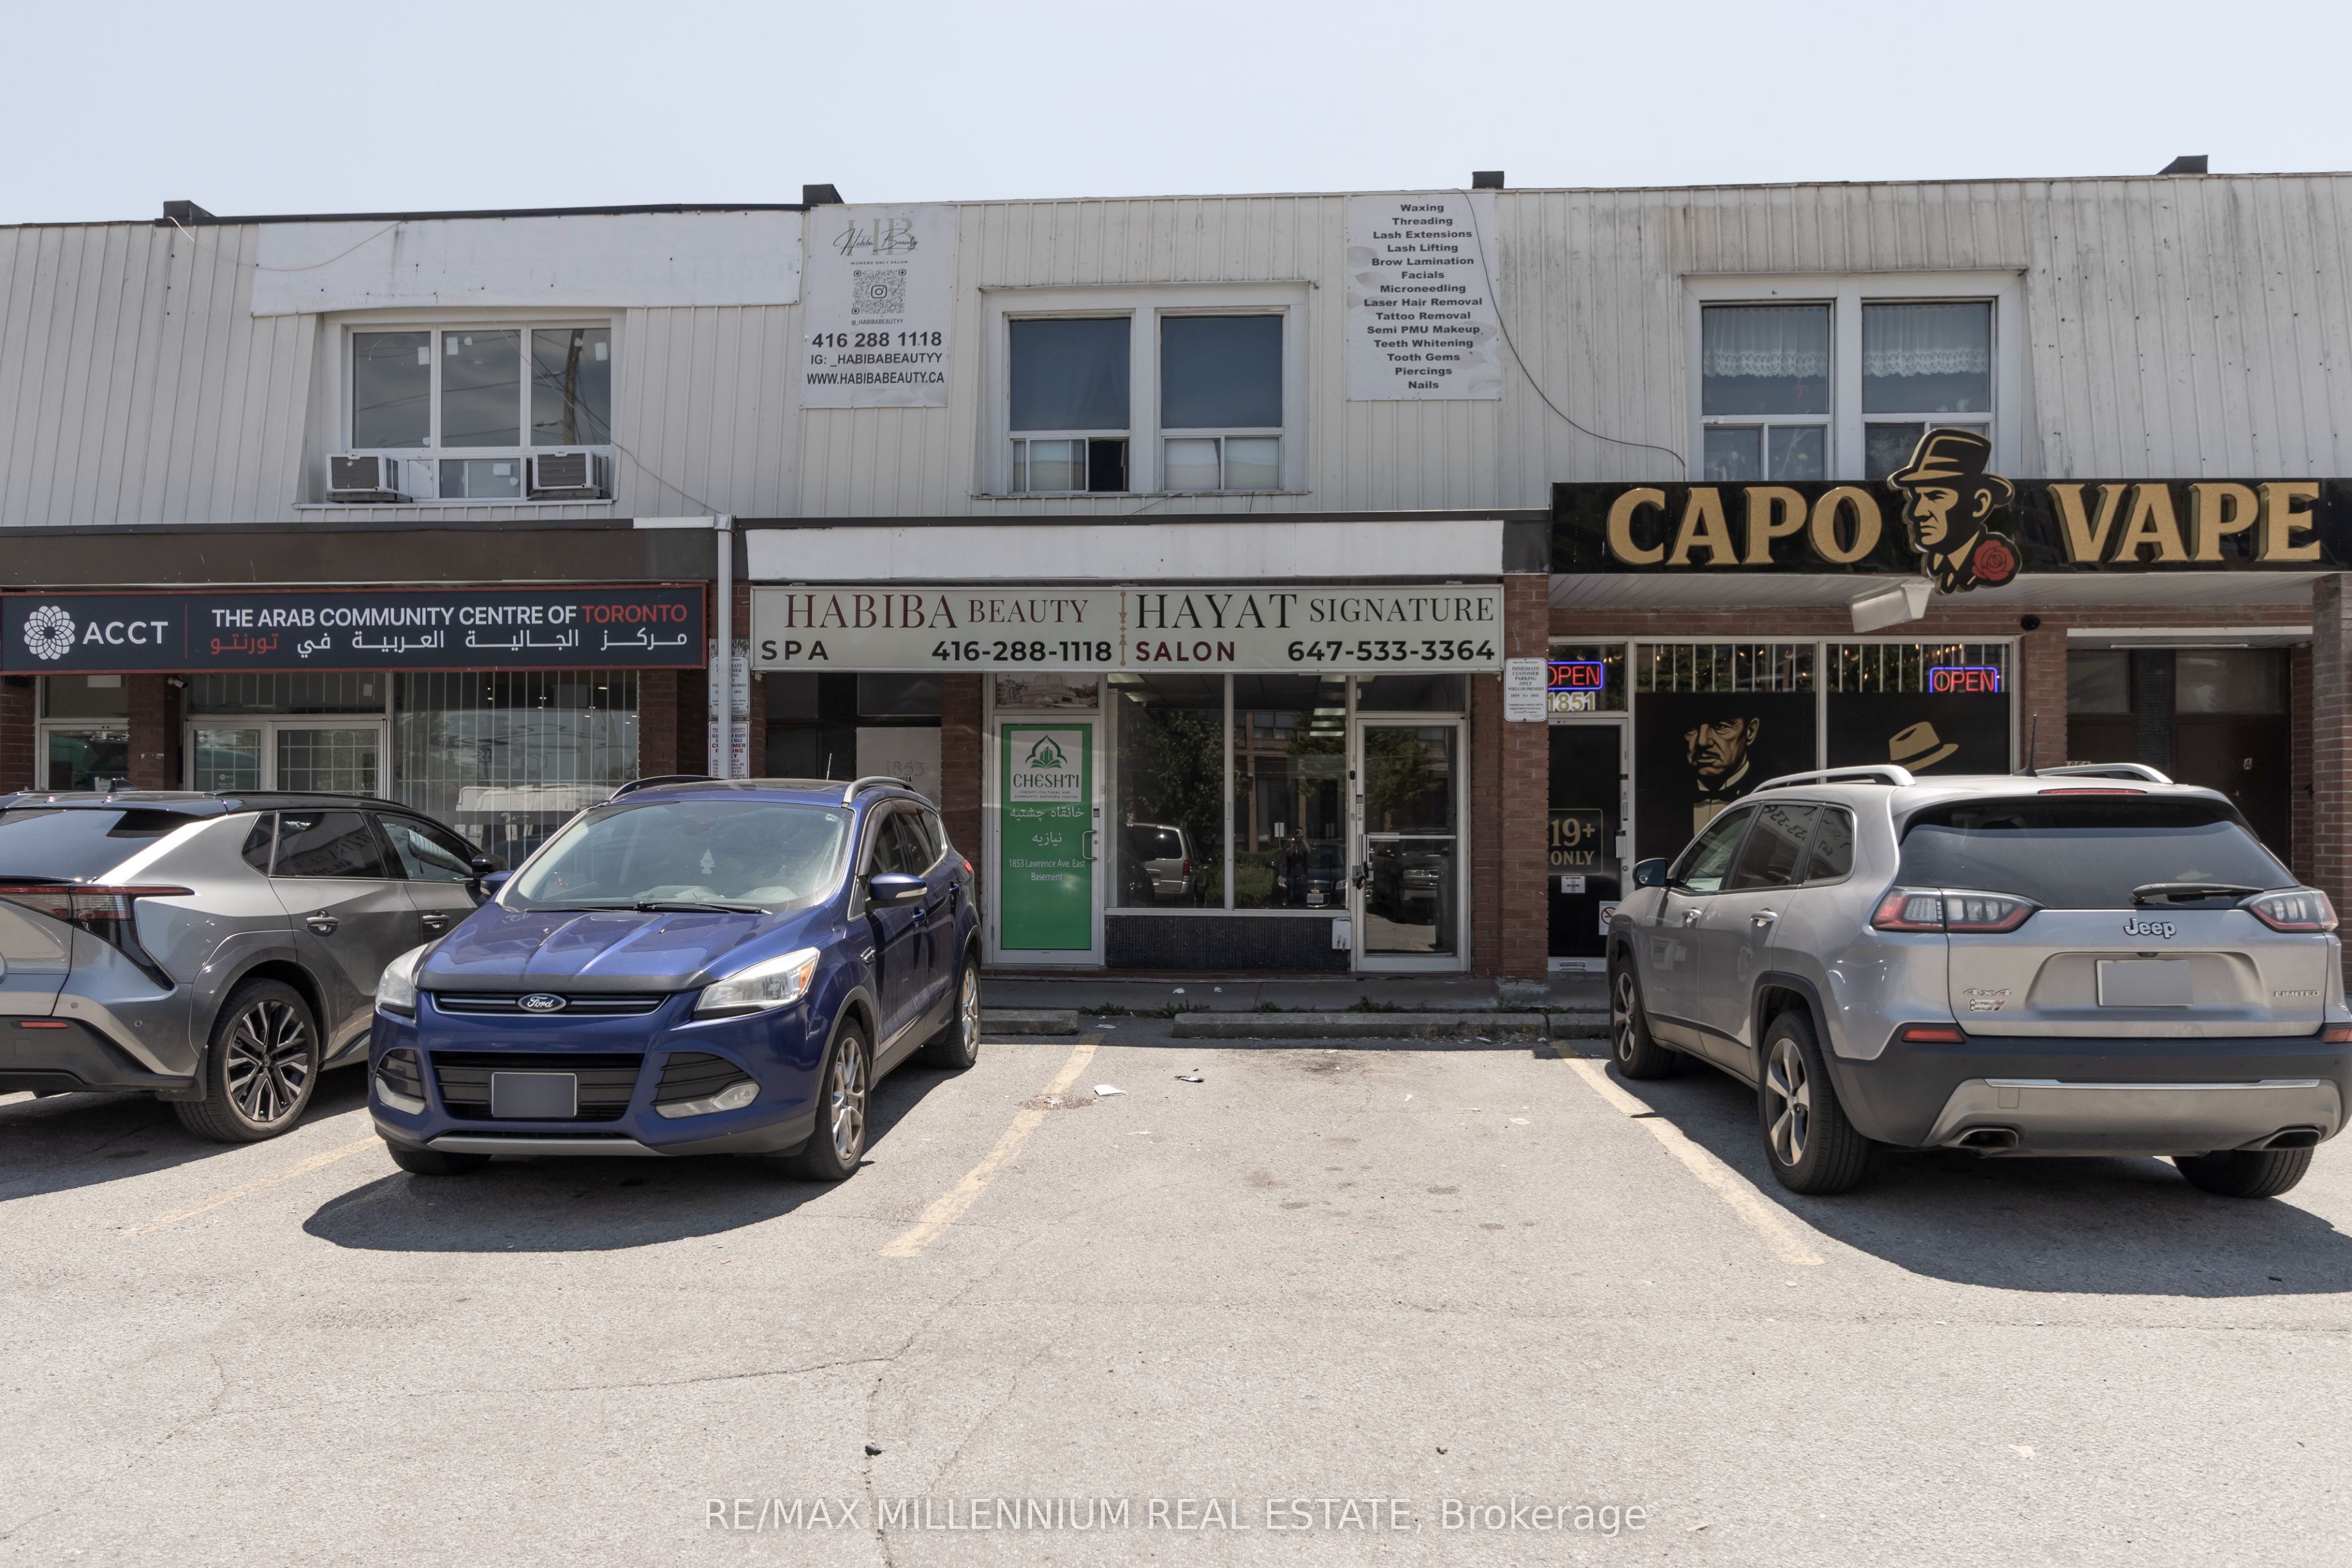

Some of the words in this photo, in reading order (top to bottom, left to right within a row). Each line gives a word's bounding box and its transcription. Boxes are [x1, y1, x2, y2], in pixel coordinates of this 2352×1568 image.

[1400, 204, 1444, 213] Waxing
[1392, 217, 1452, 226] Threading
[1420, 244, 1458, 253] Lifting
[1381, 284, 1466, 293] Microneedling
[812, 333, 847, 347] 416
[854, 333, 889, 347] 288
[898, 332, 941, 346] 1118
[1433, 326, 1480, 334] Makeup
[1412, 339, 1473, 349] Whitening
[811, 355, 826, 364] IG:
[831, 353, 942, 367] _HABIBABEAUTYY
[807, 372, 944, 384] WWW.HABIBABEAUTY.CA
[1395, 368, 1452, 376] Piercings
[1605, 485, 1882, 566] CAPO
[2048, 481, 2322, 562] VAPE
[212, 609, 253, 627] THE
[258, 609, 315, 627] ARAB
[320, 608, 454, 626] COMMUNITY
[459, 606, 543, 625] CENTRE
[548, 606, 576, 624] OF
[581, 605, 687, 623] TORONTO
[785, 595, 958, 628] HABIBA
[968, 600, 1088, 622] BEAUTY
[1136, 594, 1297, 628] HAYAT
[1310, 598, 1493, 622] SIGNATURE
[83, 622, 168, 644] ACCT
[352, 630, 443, 653] العربية
[466, 630, 578, 651] الجالية
[601, 627, 687, 650] مركز
[211, 633, 278, 654] تورنتو
[298, 633, 330, 658] في
[761, 641, 829, 660] SPA
[932, 641, 1112, 662] 416-288-1118
[1136, 641, 1234, 662] SALON
[1288, 640, 1494, 661] 647-533-3364
[1548, 666, 1600, 685] OPEN
[1933, 671, 1996, 692] OPEN
[1548, 692, 1595, 712] 1851
[1013, 774, 1079, 788] CHESHTI
[1050, 806, 1084, 817] خانقاه
[1551, 818, 1596, 847] 19+
[1550, 850, 1595, 866] ONLY
[1031, 872, 1062, 881] Basement
[2124, 918, 2176, 939] Jeep
[525, 995, 554, 1009] Ford
